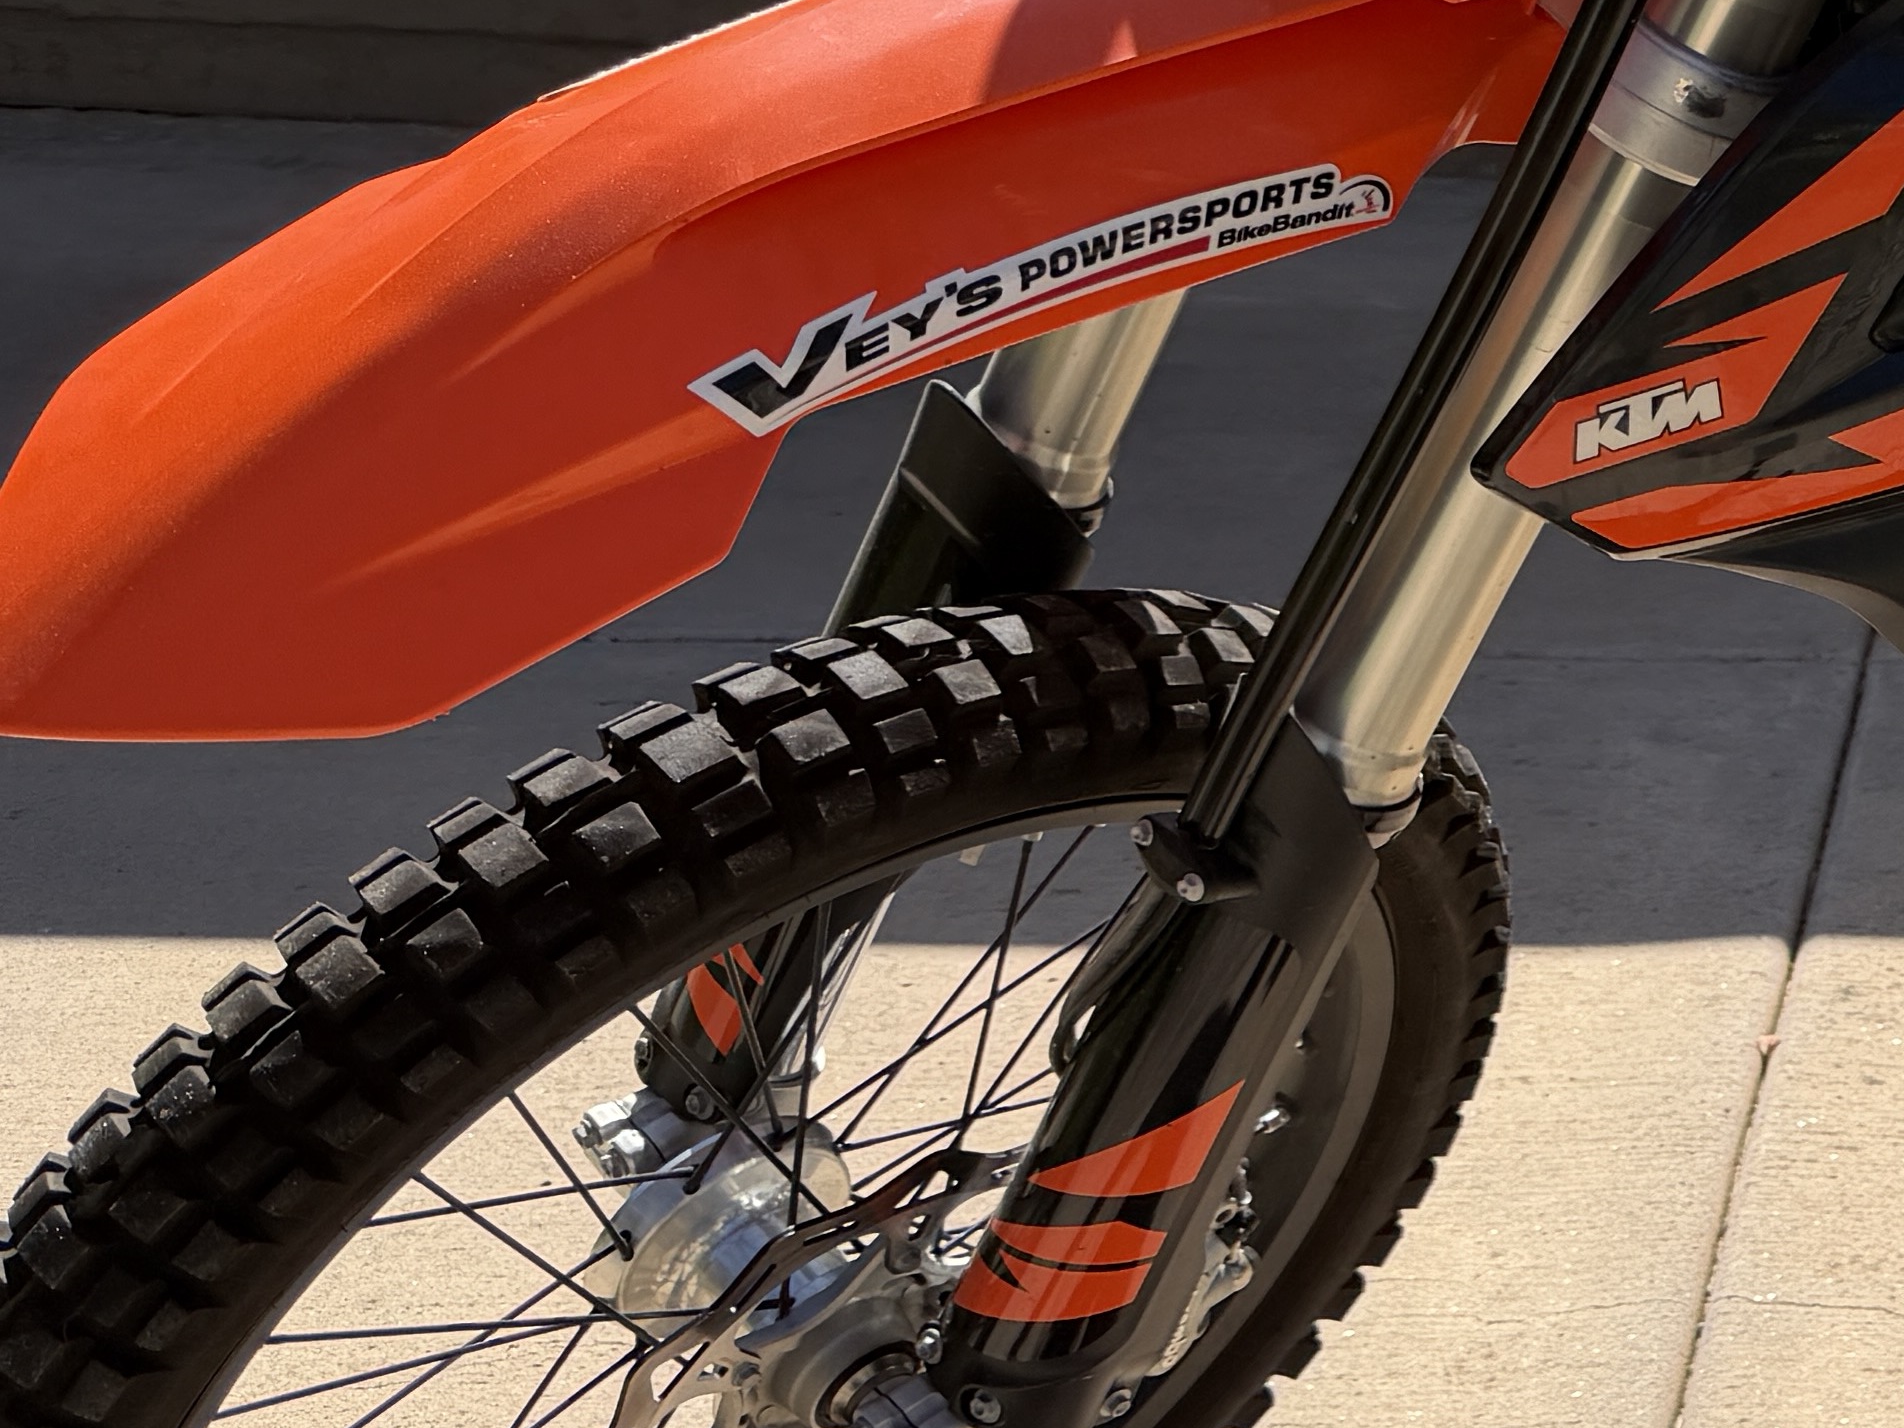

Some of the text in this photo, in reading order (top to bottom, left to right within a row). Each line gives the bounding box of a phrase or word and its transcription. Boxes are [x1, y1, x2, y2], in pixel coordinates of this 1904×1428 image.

[1019, 171, 1336, 292] POWERSPORTS
[1217, 199, 1355, 249] BikeBandit
[1575, 378, 1723, 462] KTM
